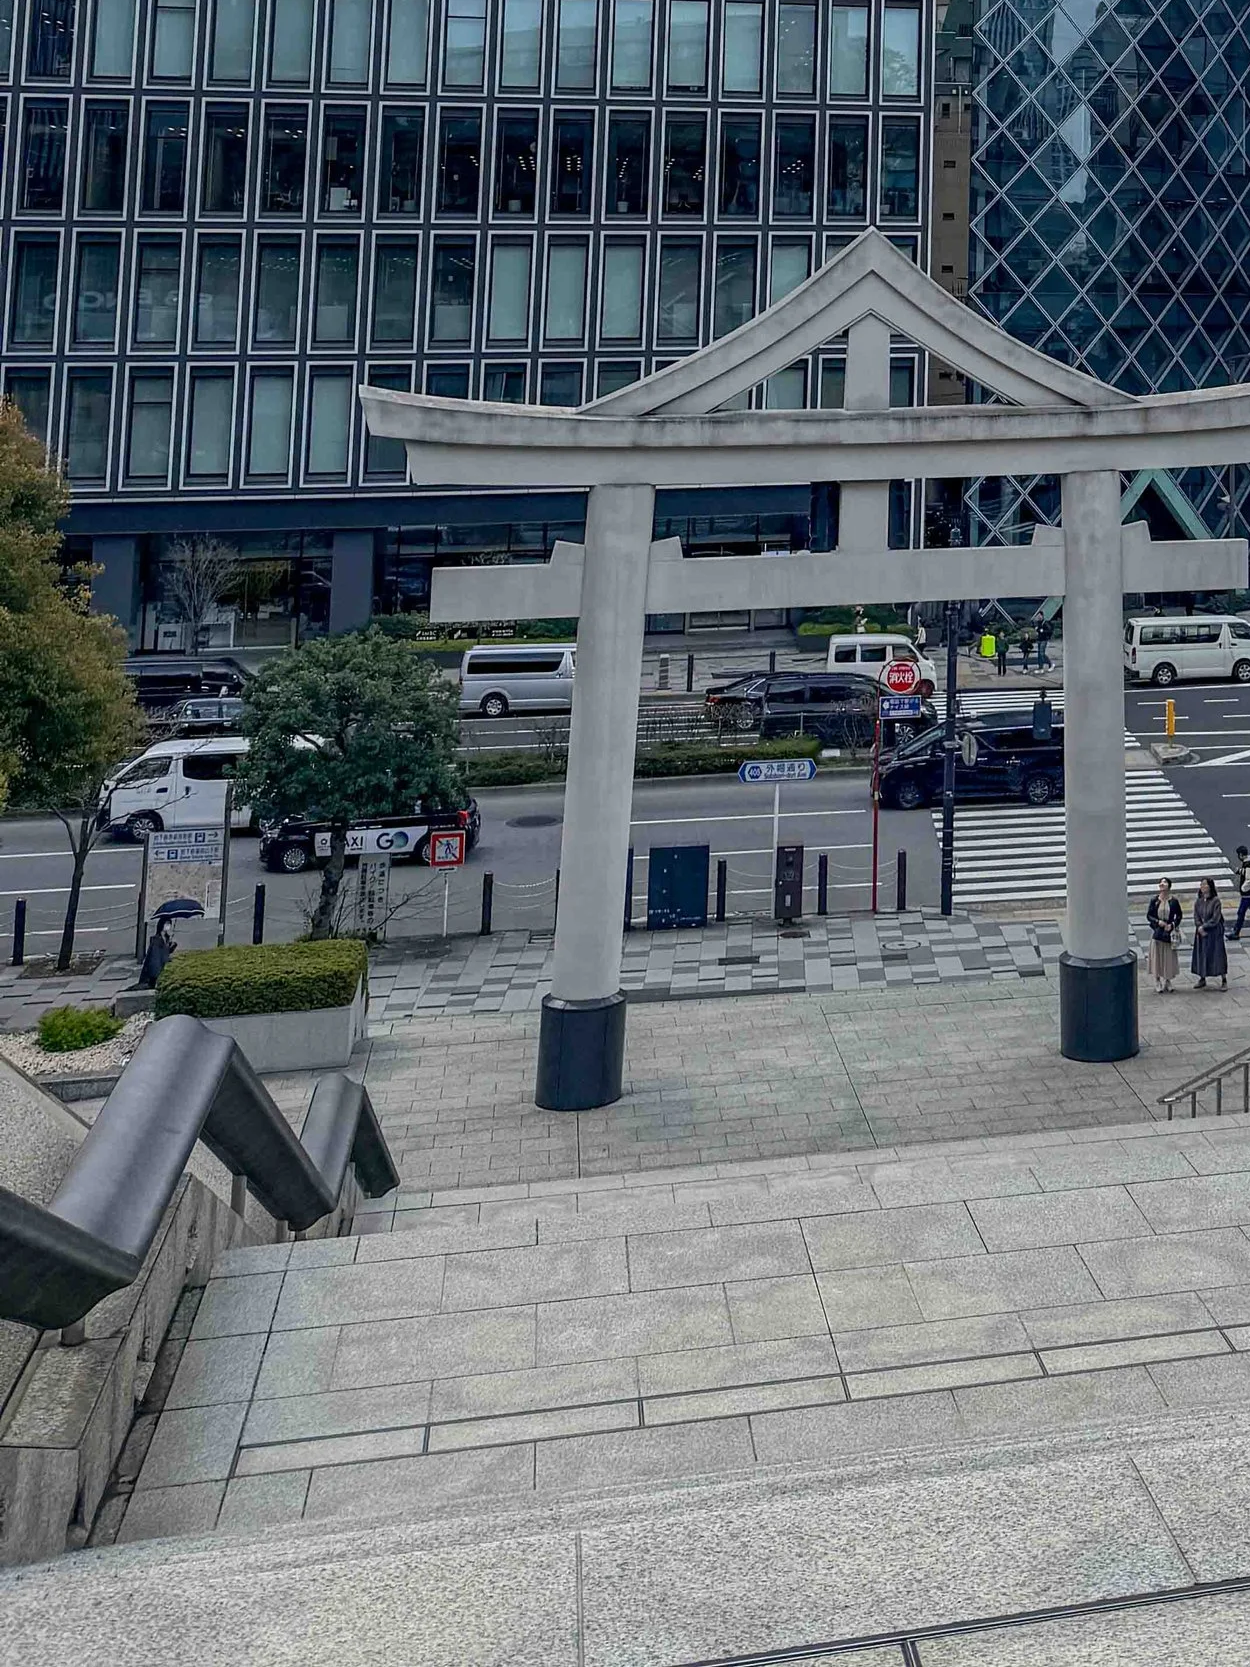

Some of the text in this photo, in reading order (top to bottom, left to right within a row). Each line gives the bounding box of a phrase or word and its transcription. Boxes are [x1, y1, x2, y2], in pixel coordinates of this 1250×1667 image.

[888, 671, 914, 684] 消火栓
[376, 831, 409, 850] GO
